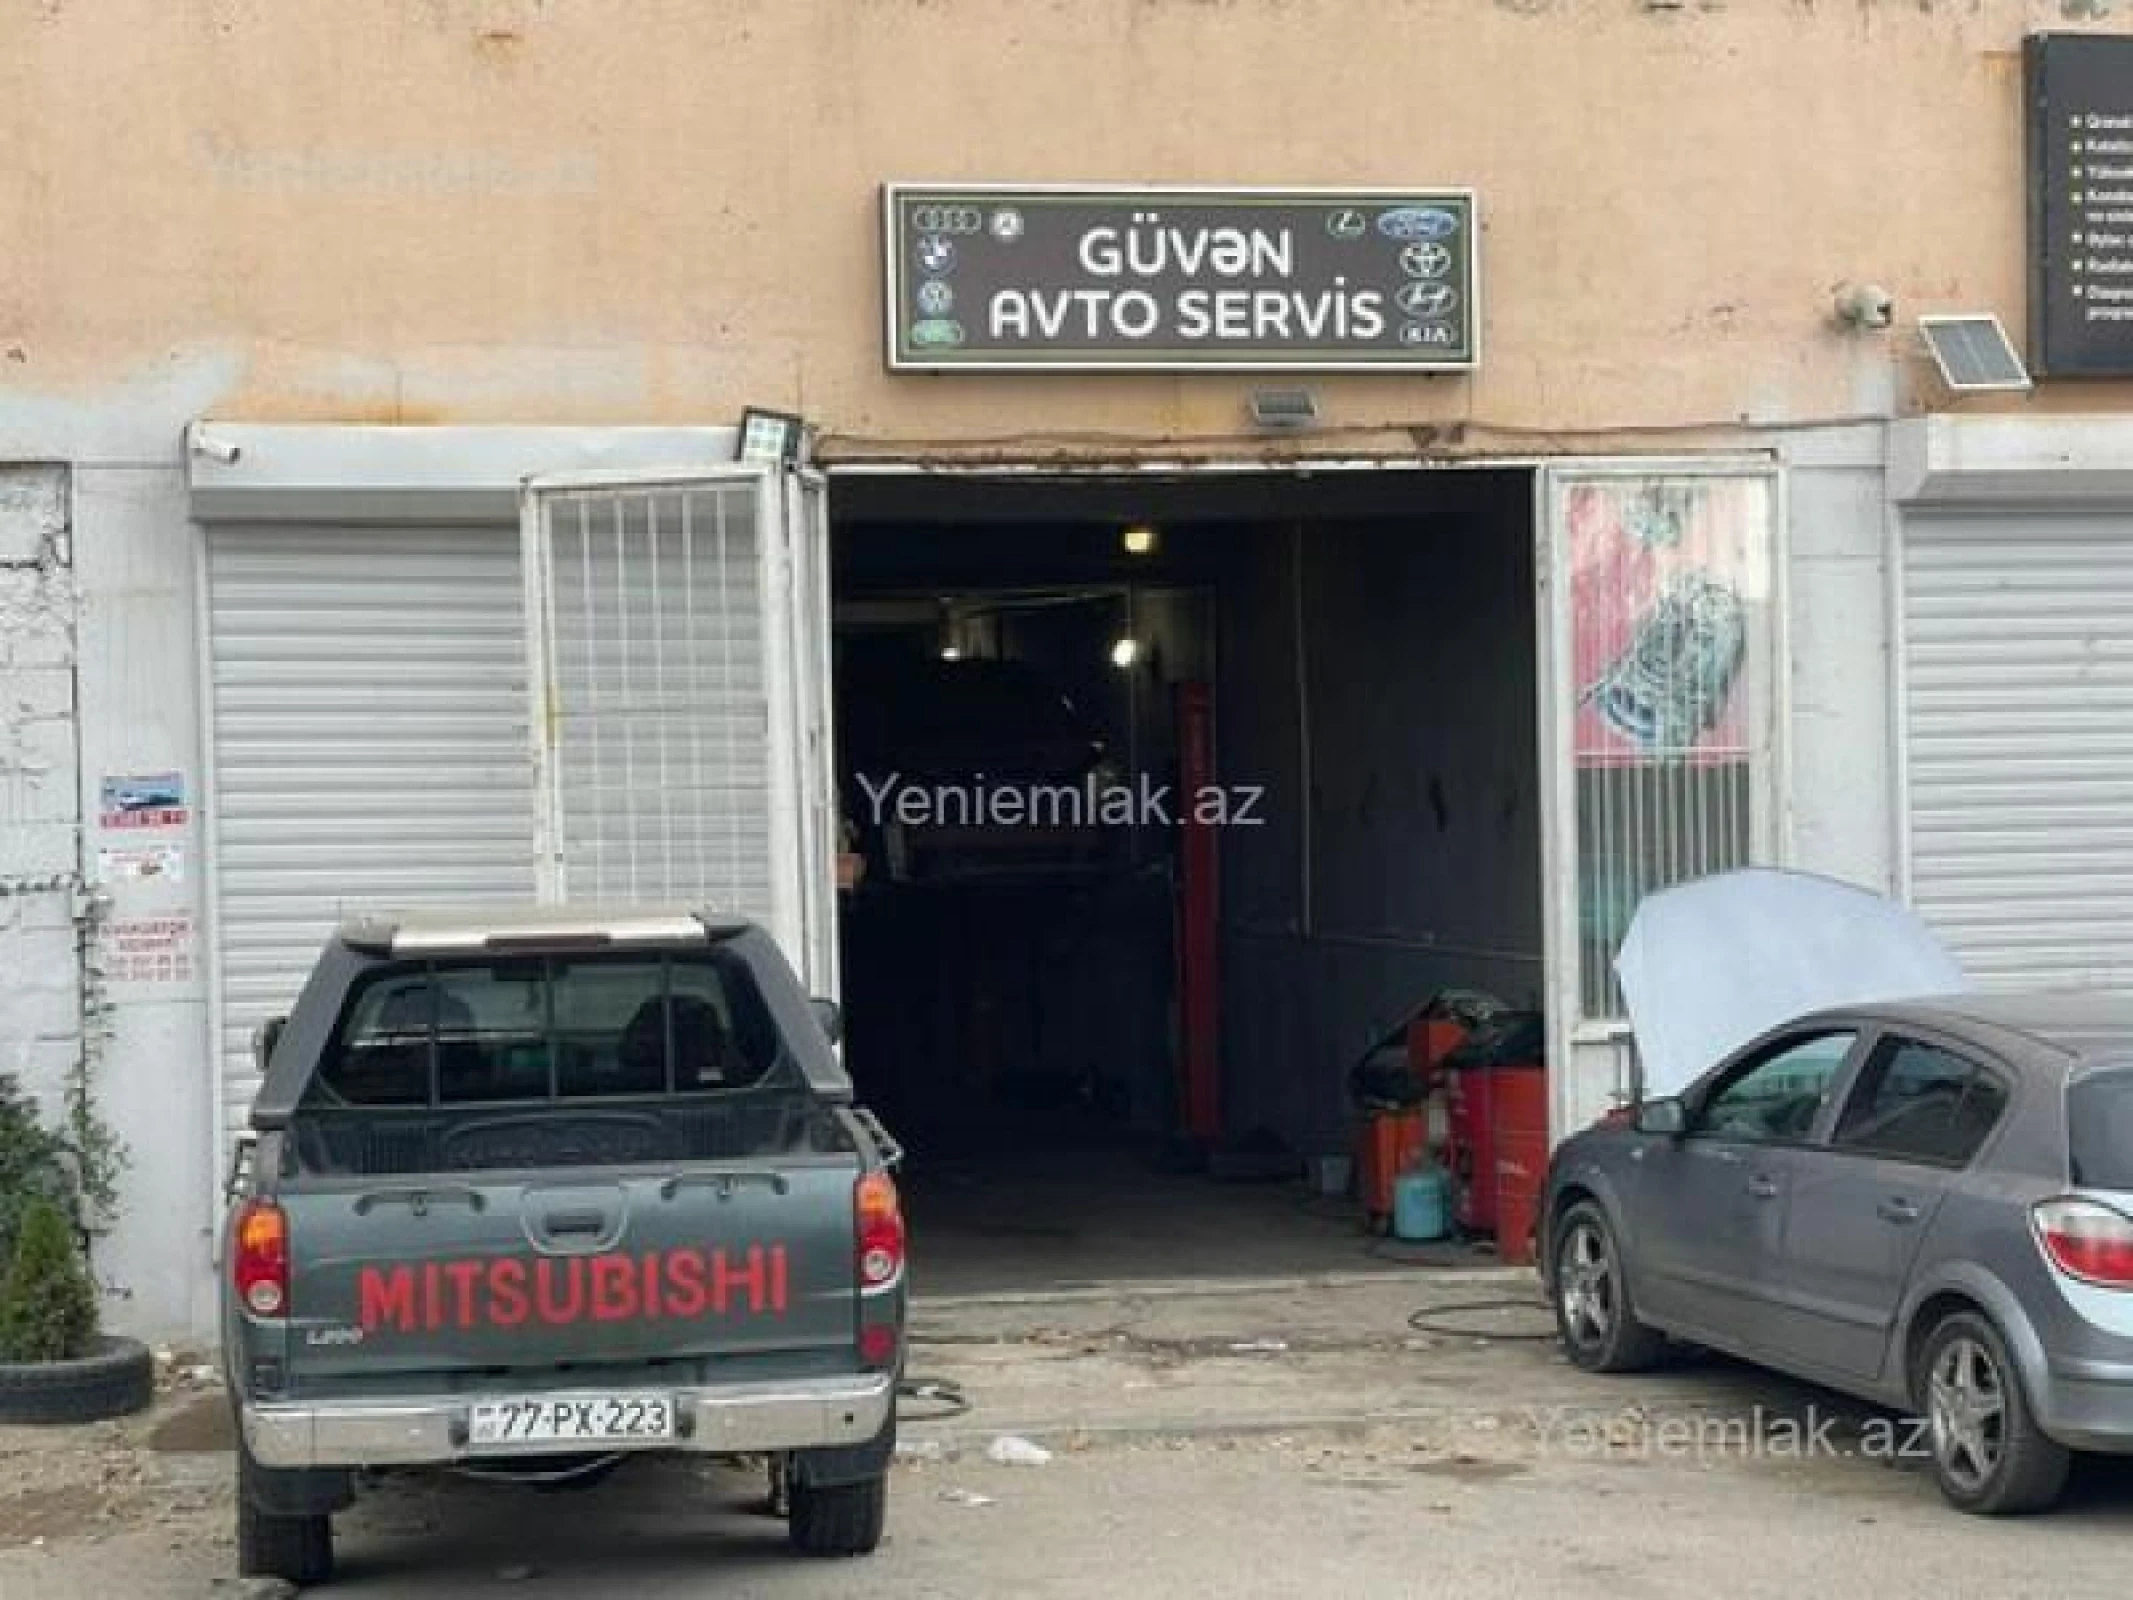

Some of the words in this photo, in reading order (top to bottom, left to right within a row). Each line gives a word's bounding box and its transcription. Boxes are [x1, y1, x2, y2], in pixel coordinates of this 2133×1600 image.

[1079, 212, 1294, 277] GÜVƏN
[988, 290, 1160, 340] AVTO
[1177, 276, 1385, 340] SERVİS
[357, 1244, 789, 1333] MITSUBISHI
